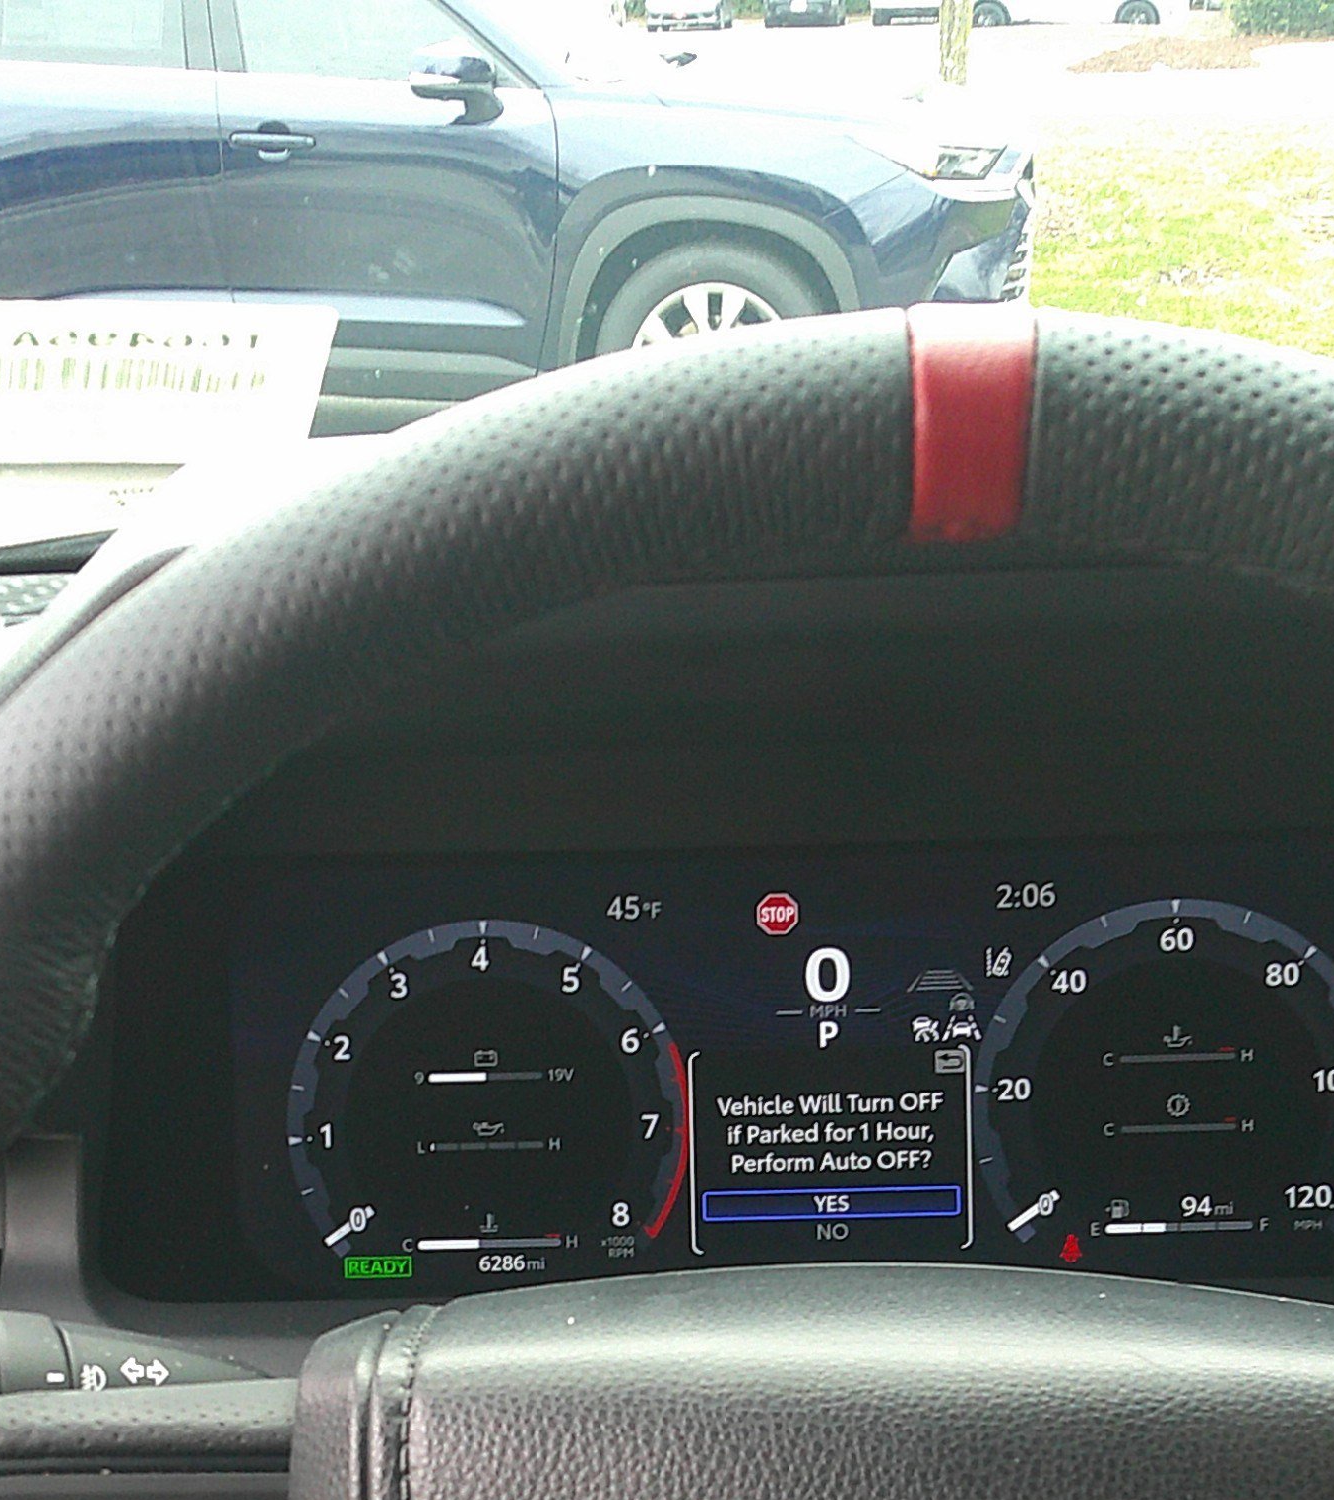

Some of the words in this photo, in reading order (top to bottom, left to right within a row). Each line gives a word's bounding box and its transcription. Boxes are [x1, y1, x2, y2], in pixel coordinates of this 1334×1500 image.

[995, 882, 1057, 909] 2:06
[760, 905, 795, 923] STOP
[1159, 927, 1195, 951] 60
[471, 946, 489, 971] 4
[561, 967, 580, 993] 5
[804, 945, 852, 1003] 0
[1051, 969, 1087, 994] 40
[1265, 962, 1300, 987] 80
[390, 973, 409, 999] 3
[808, 1003, 848, 1018] MPH
[620, 1028, 640, 1053] 6
[818, 1021, 839, 1049] P
[333, 1035, 352, 1061] 2
[1240, 1049, 1254, 1063] H
[1102, 1052, 1114, 1068] C
[413, 1070, 425, 1086] 9
[546, 1067, 575, 1084] 19V
[996, 1077, 1032, 1102] 20
[716, 1095, 795, 1118] Vehicle
[798, 1094, 842, 1115] Will
[843, 1094, 894, 1114] Turn
[899, 1091, 945, 1112] OFF
[319, 1123, 334, 1150] 1
[640, 1112, 661, 1140] 7
[726, 1123, 744, 1145] if
[746, 1122, 820, 1145] Parked
[824, 1120, 856, 1143] for
[860, 1122, 870, 1142] 1
[875, 1120, 935, 1145] Hour,
[1103, 1122, 1115, 1137] C
[1241, 1119, 1254, 1133] H
[416, 1140, 426, 1155] L
[548, 1137, 562, 1151] H
[729, 1152, 815, 1174] Perform
[818, 1151, 872, 1172] Auto
[876, 1150, 932, 1170] OFF?
[813, 1195, 851, 1214] YES
[1038, 1193, 1054, 1215] 0
[1284, 1184, 1333, 1209] 120
[349, 1206, 367, 1232] 0
[611, 1202, 631, 1228] 8
[1258, 1217, 1270, 1232] F
[1292, 1218, 1324, 1232] MPH
[815, 1223, 850, 1241] NO
[1090, 1222, 1101, 1237] E
[402, 1237, 414, 1253] C
[565, 1234, 579, 1249] H
[607, 1245, 636, 1259] RPM
[347, 1258, 409, 1276] READY
